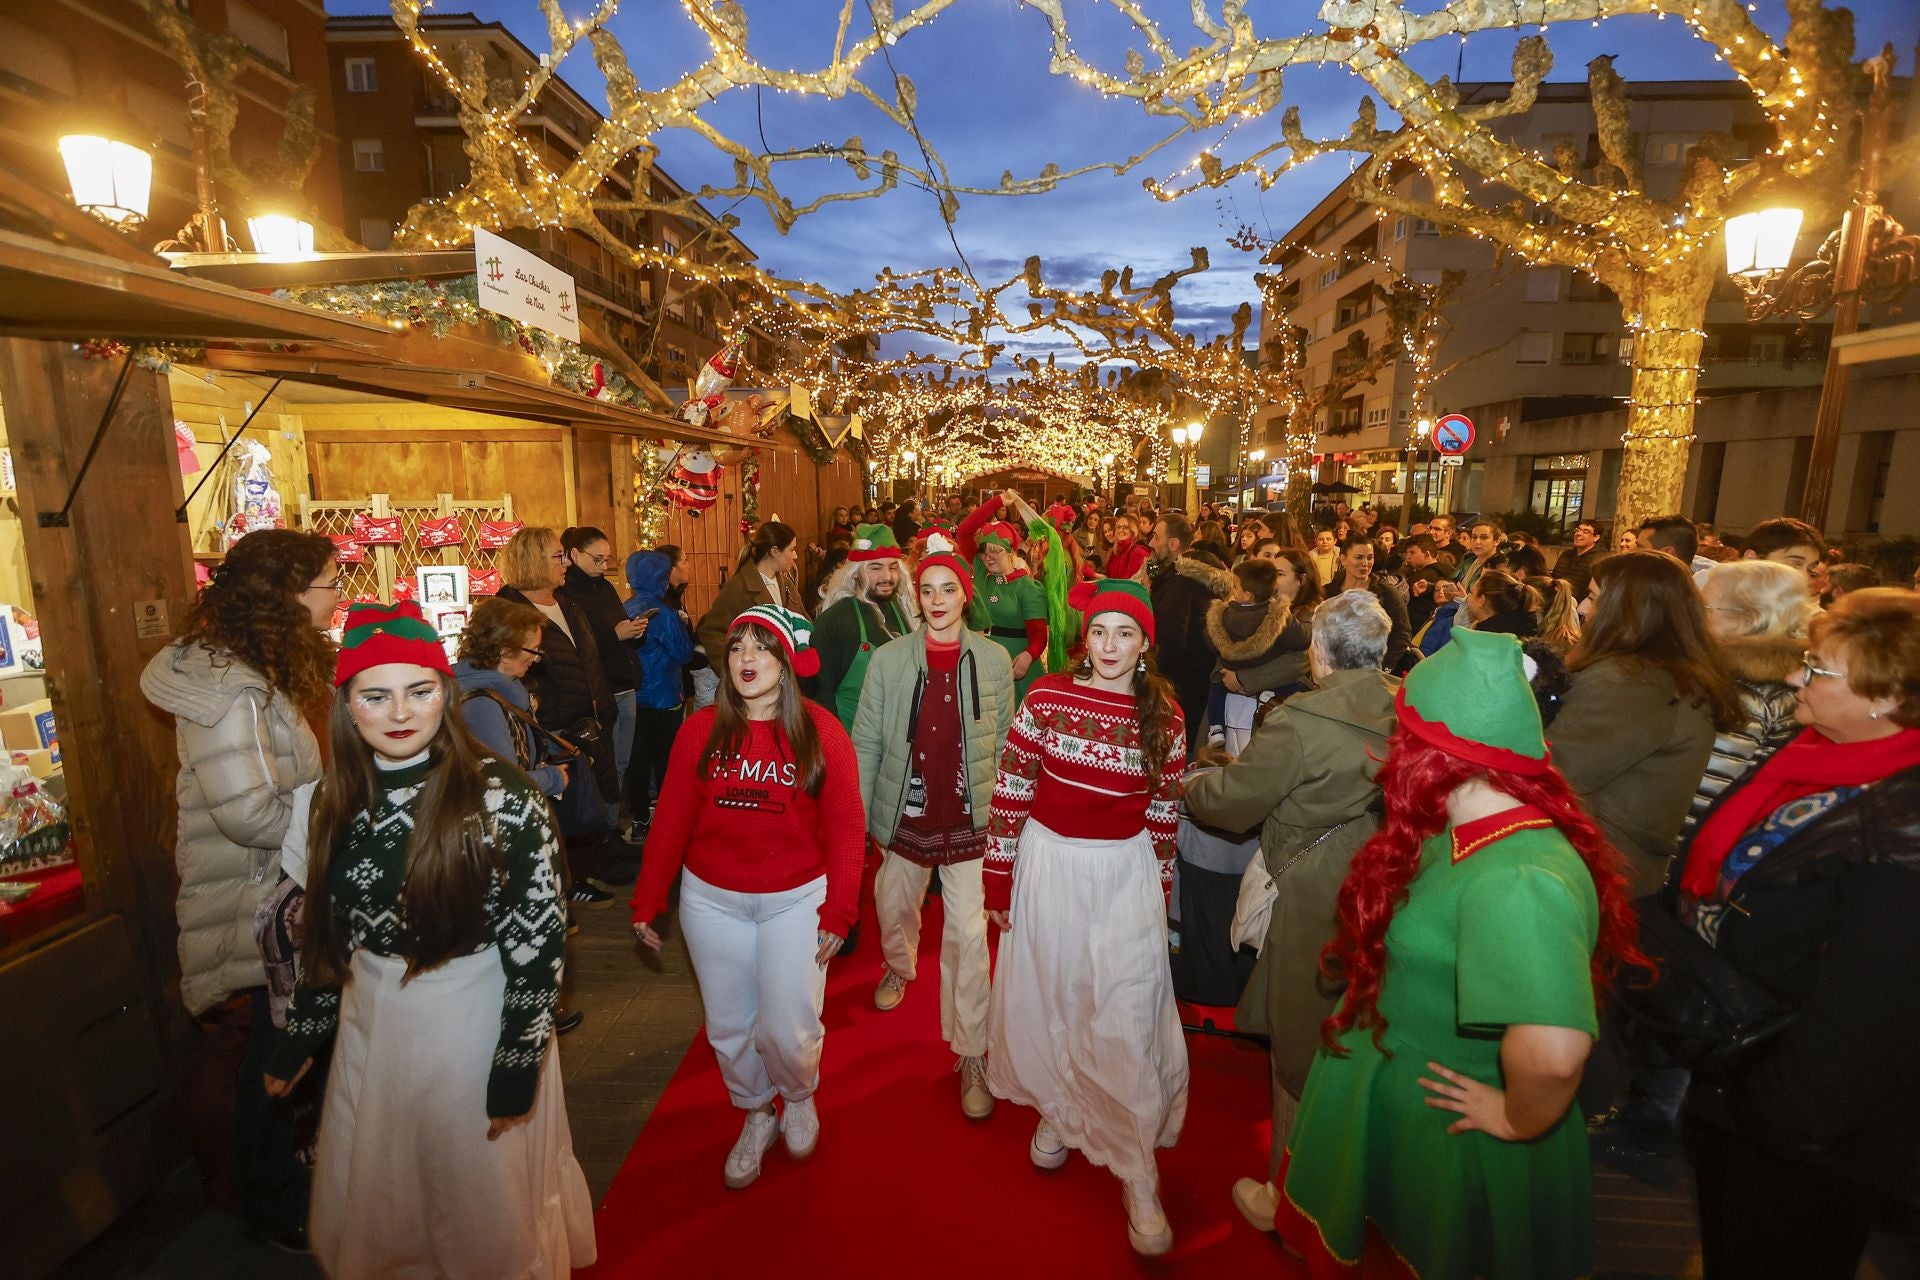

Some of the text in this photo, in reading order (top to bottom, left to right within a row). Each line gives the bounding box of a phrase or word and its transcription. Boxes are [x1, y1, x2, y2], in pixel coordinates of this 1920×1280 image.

[515, 268, 528, 283] Las
[528, 273, 551, 294] Chuches
[525, 294, 533, 306] de
[725, 787, 770, 800] LOADING
